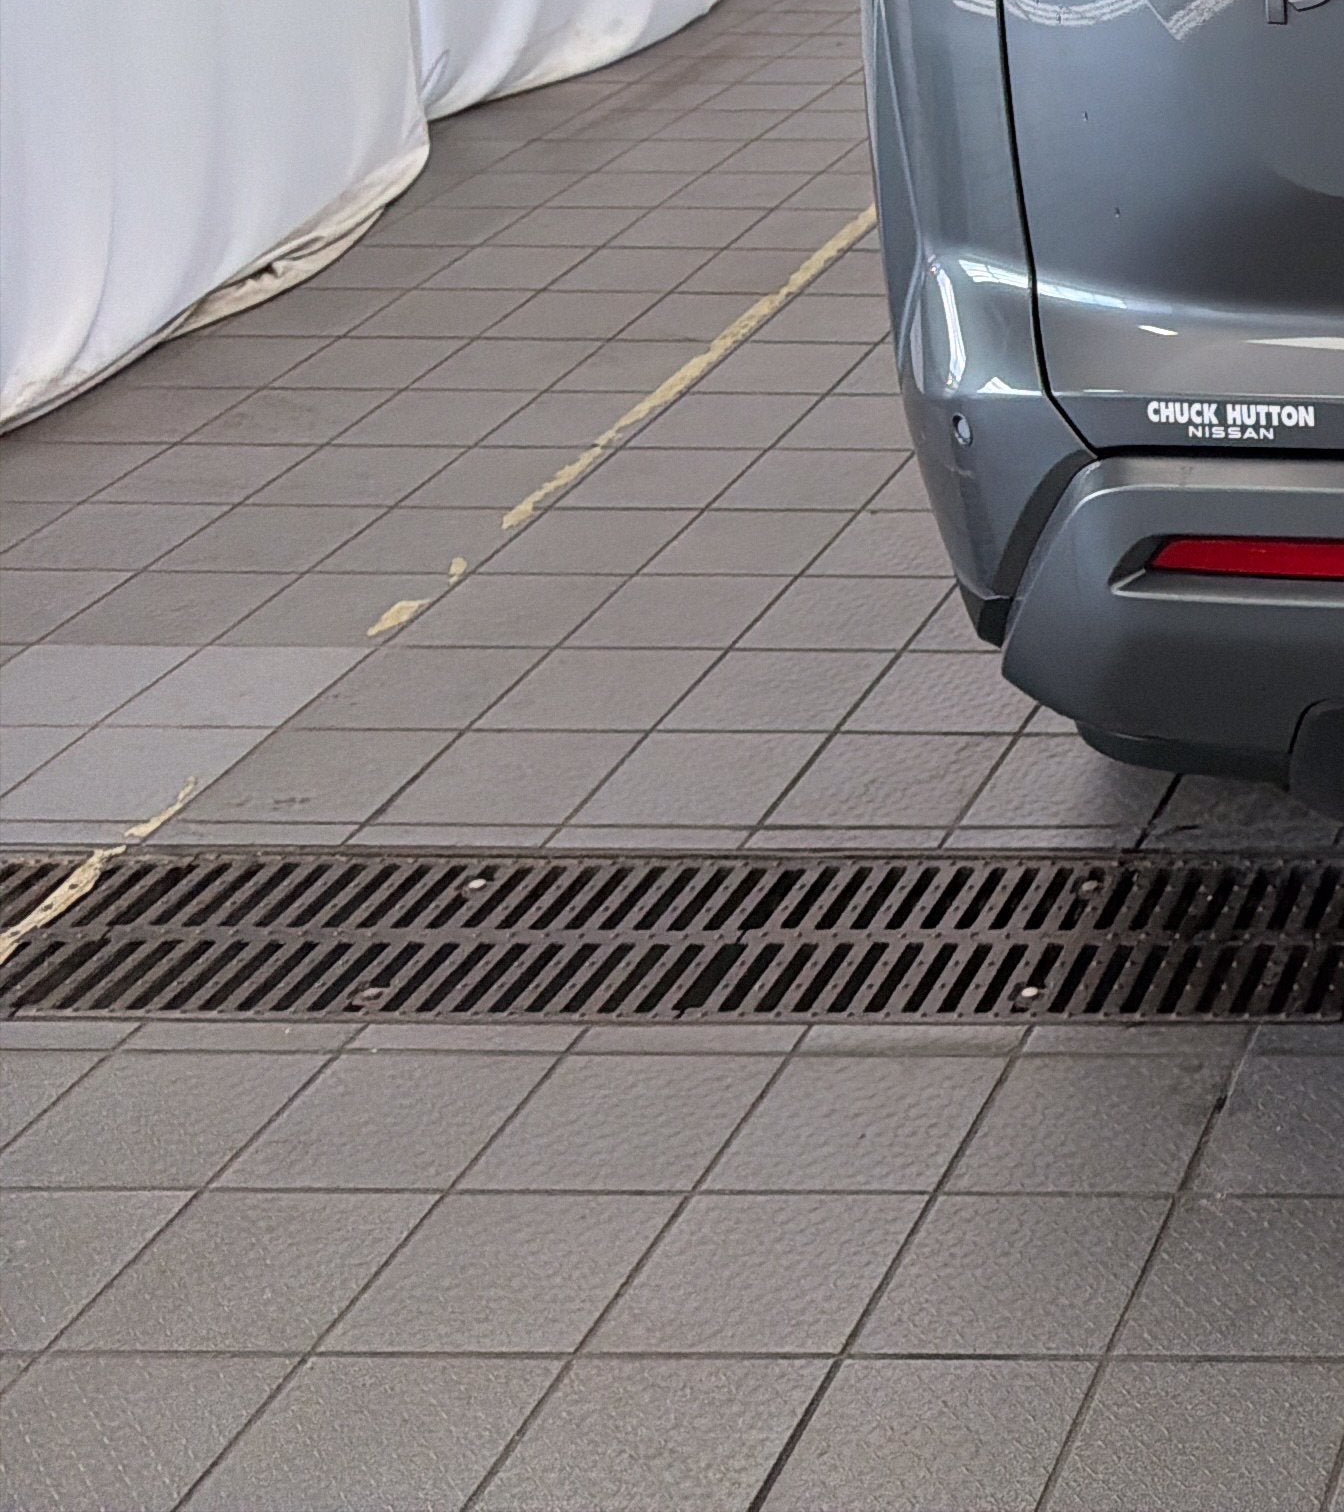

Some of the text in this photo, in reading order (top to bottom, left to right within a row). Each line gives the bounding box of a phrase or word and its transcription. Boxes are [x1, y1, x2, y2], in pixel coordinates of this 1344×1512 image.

[1147, 400, 1316, 427] CHUCK HUTTON
[1188, 425, 1275, 439] NISSAN
